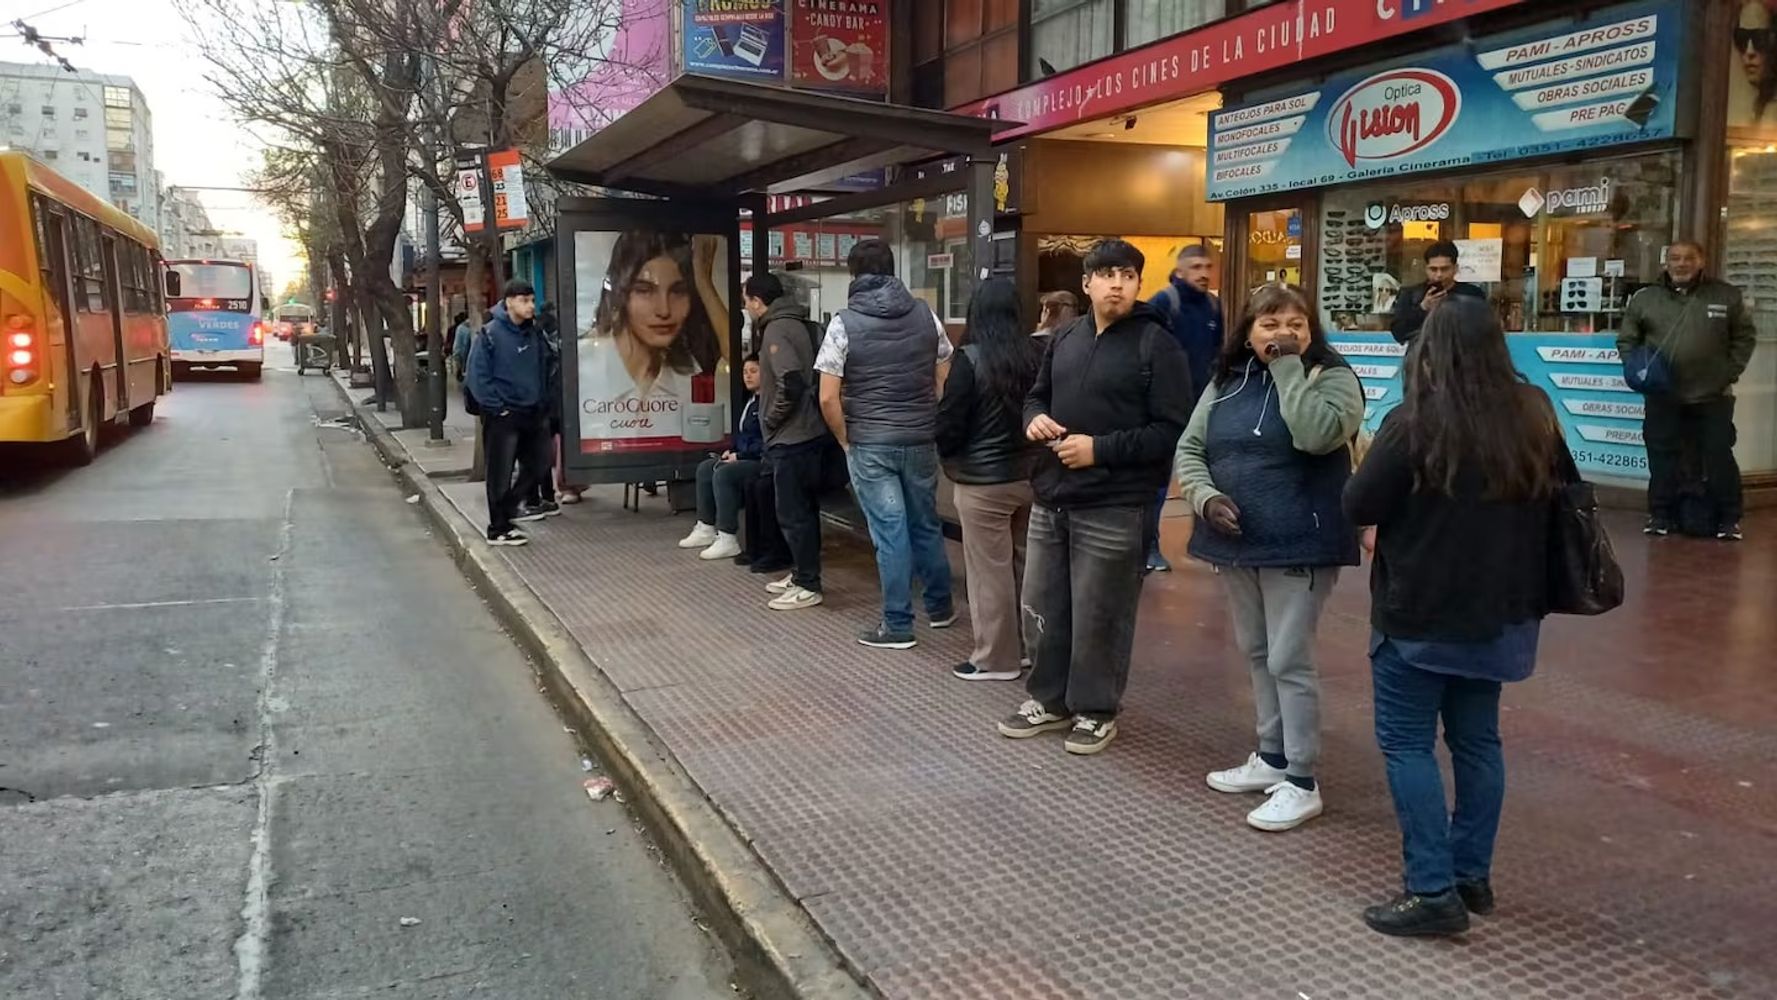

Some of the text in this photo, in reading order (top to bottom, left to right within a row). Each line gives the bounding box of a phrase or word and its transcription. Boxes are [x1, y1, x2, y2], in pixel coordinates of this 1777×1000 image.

[799, 0, 877, 14] CINERAMA
[810, 13, 865, 30] CANDY BAR
[1506, 43, 1551, 61] PAMI
[1564, 20, 1649, 50] APROSS
[1097, 72, 1122, 98] LOS
[1132, 55, 1179, 88] CINES
[1191, 45, 1210, 72] DE
[1223, 35, 1243, 63] LA
[1257, 7, 1335, 53] CIUDAD
[1384, 83, 1422, 101] Optica
[1537, 72, 1647, 103] OBRAS SOCIALES
[1218, 98, 1307, 126] ANTEOJOS PARA SOL
[1570, 102, 1626, 122] PRE PAG
[1217, 123, 1280, 143] MONOFOCALES
[1217, 143, 1279, 161] MULTIFOCALES
[1216, 165, 1262, 181] BIFOCALES
[1260, 183, 1279, 191] 335
[1289, 178, 1317, 189] local
[1321, 175, 1335, 183] 69
[1399, 156, 1470, 171] Cinerama
[496, 196, 507, 206] 21
[1546, 176, 1609, 214] pami
[497, 209, 508, 218] 25
[1389, 203, 1450, 224] Apross
[228, 300, 248, 310] 2510
[199, 320, 240, 329] VERDES
[1551, 350, 1585, 359] PAMI
[1562, 375, 1603, 386] MUTUALES
[583, 398, 679, 414] CaroCuore
[1582, 403, 1645, 416] OBRAS SOCIA
[1572, 450, 1647, 468] 351-422865
